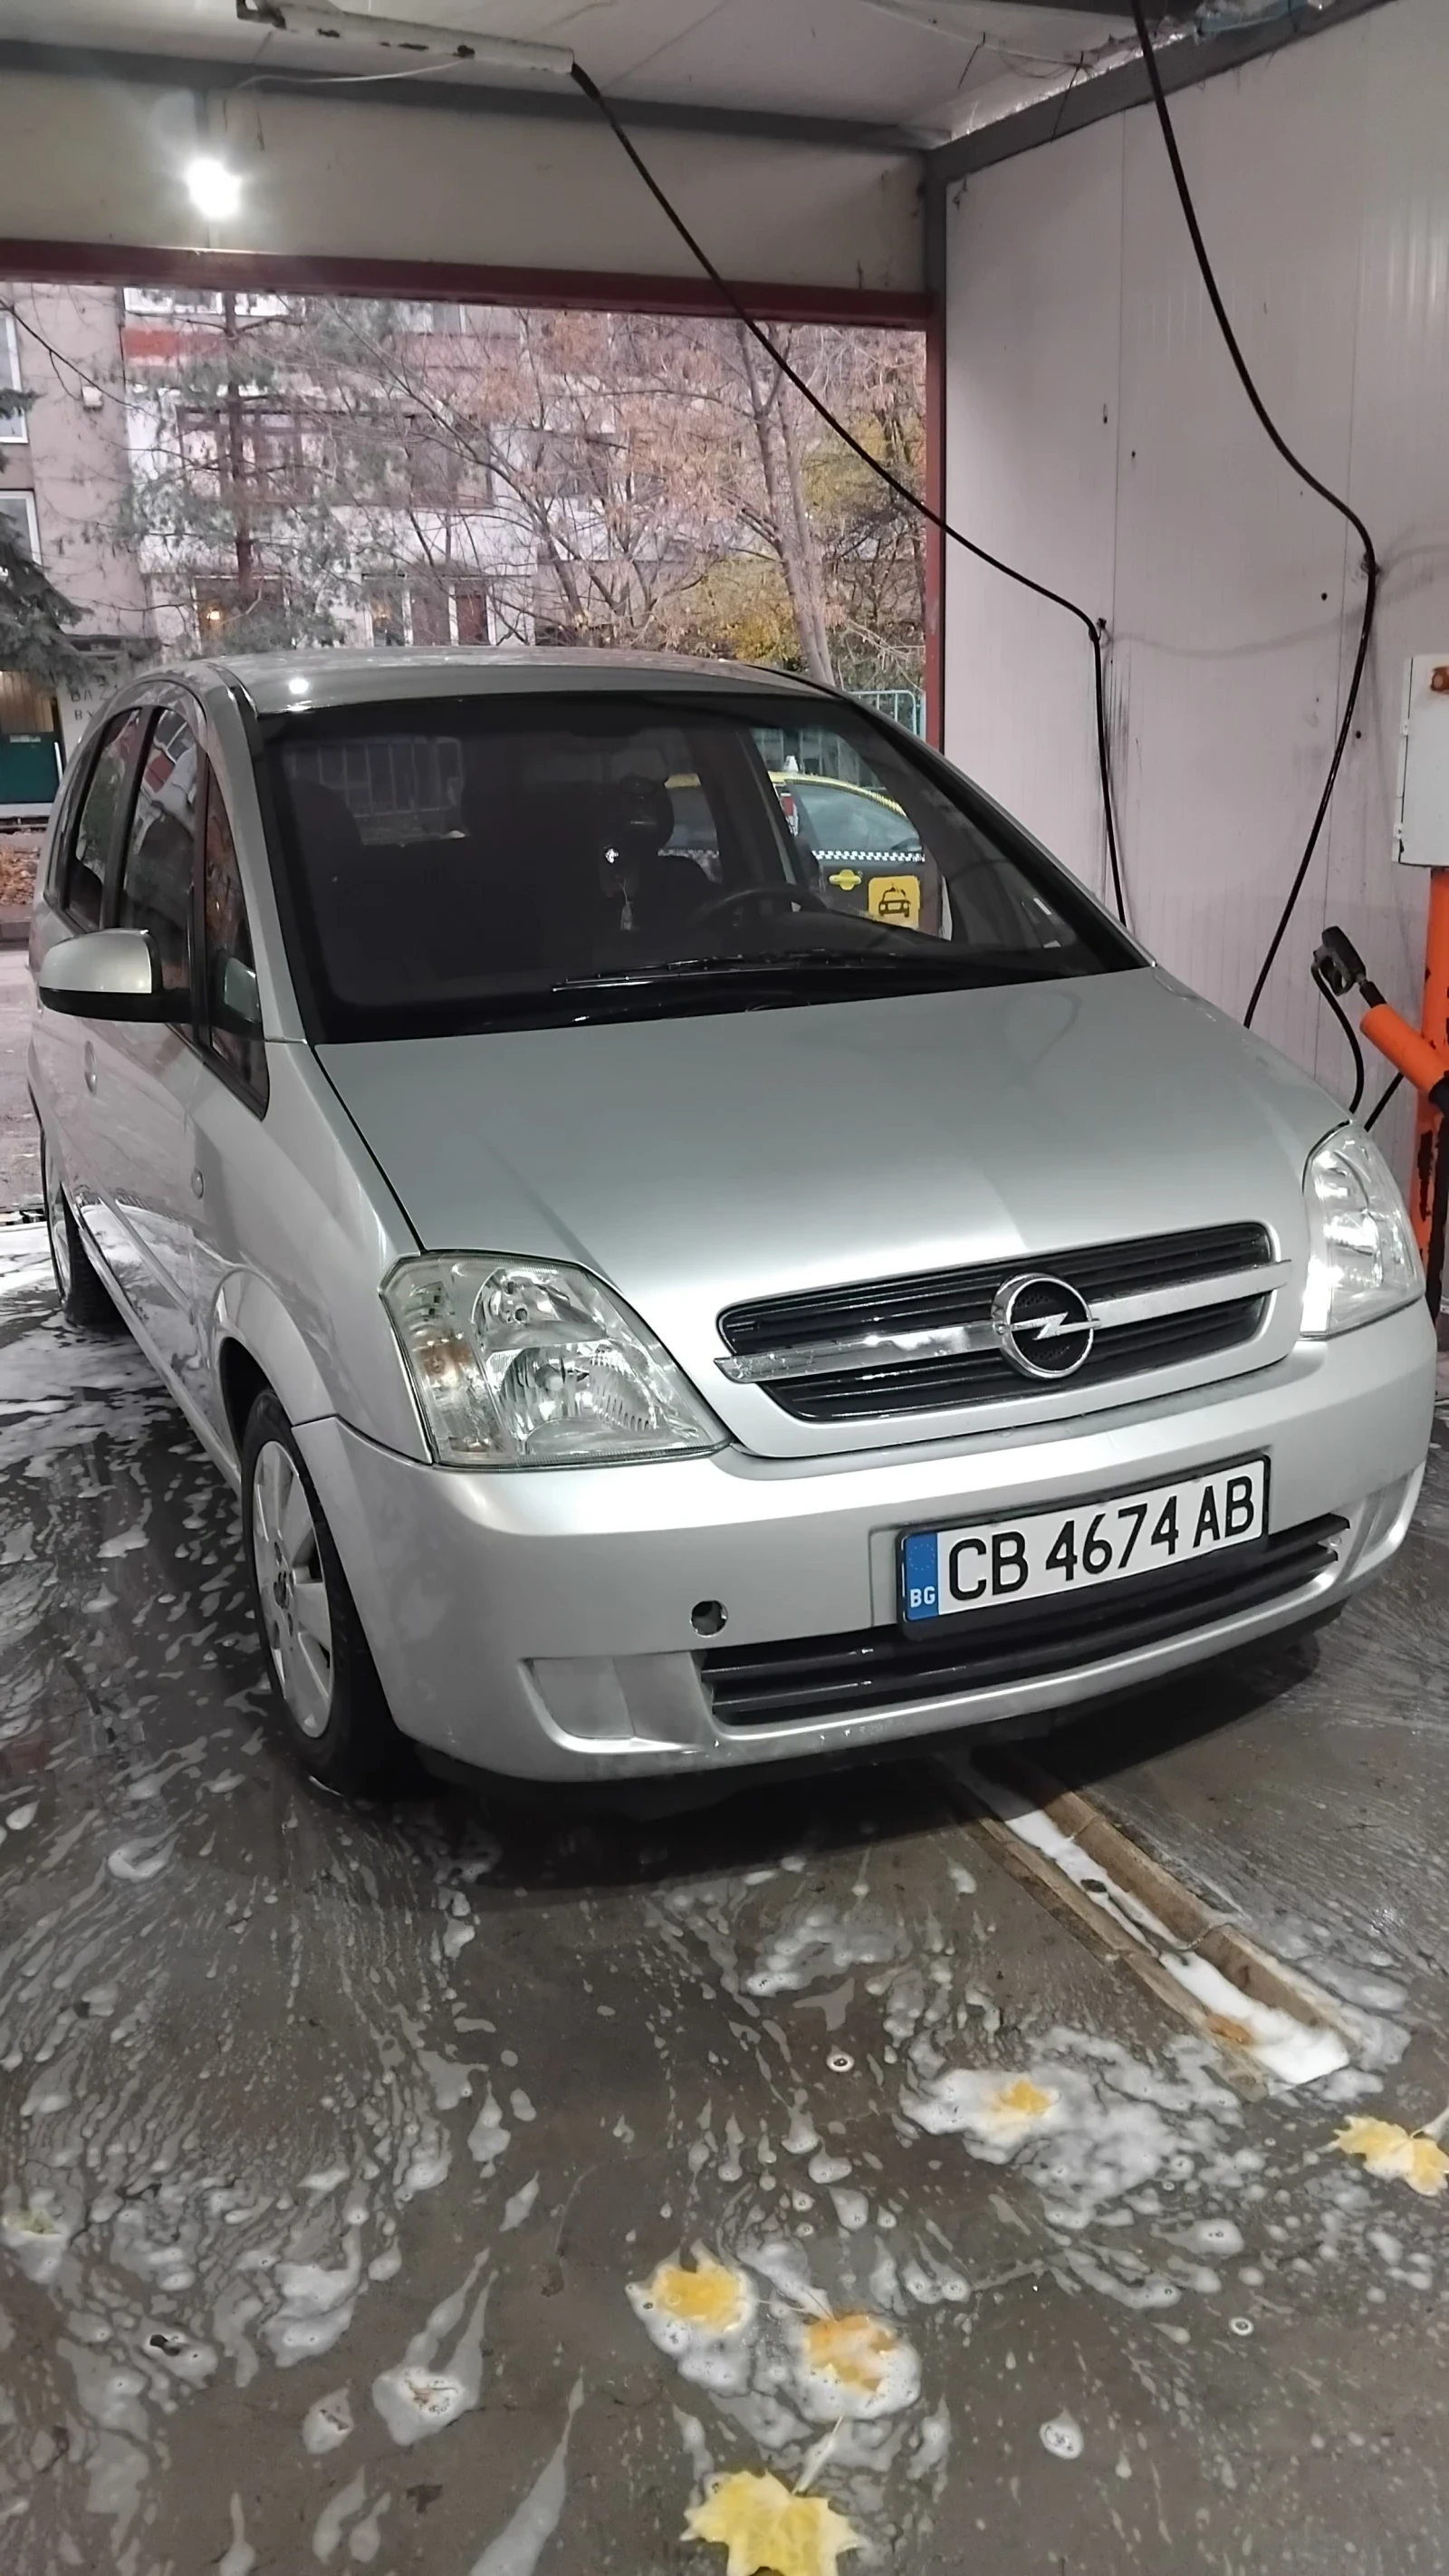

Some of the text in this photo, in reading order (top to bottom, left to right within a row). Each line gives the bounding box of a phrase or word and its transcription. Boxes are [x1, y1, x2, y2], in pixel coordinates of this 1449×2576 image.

[949, 1475, 1254, 1601] CB 4674 AB
[909, 1585, 936, 1609] BG
